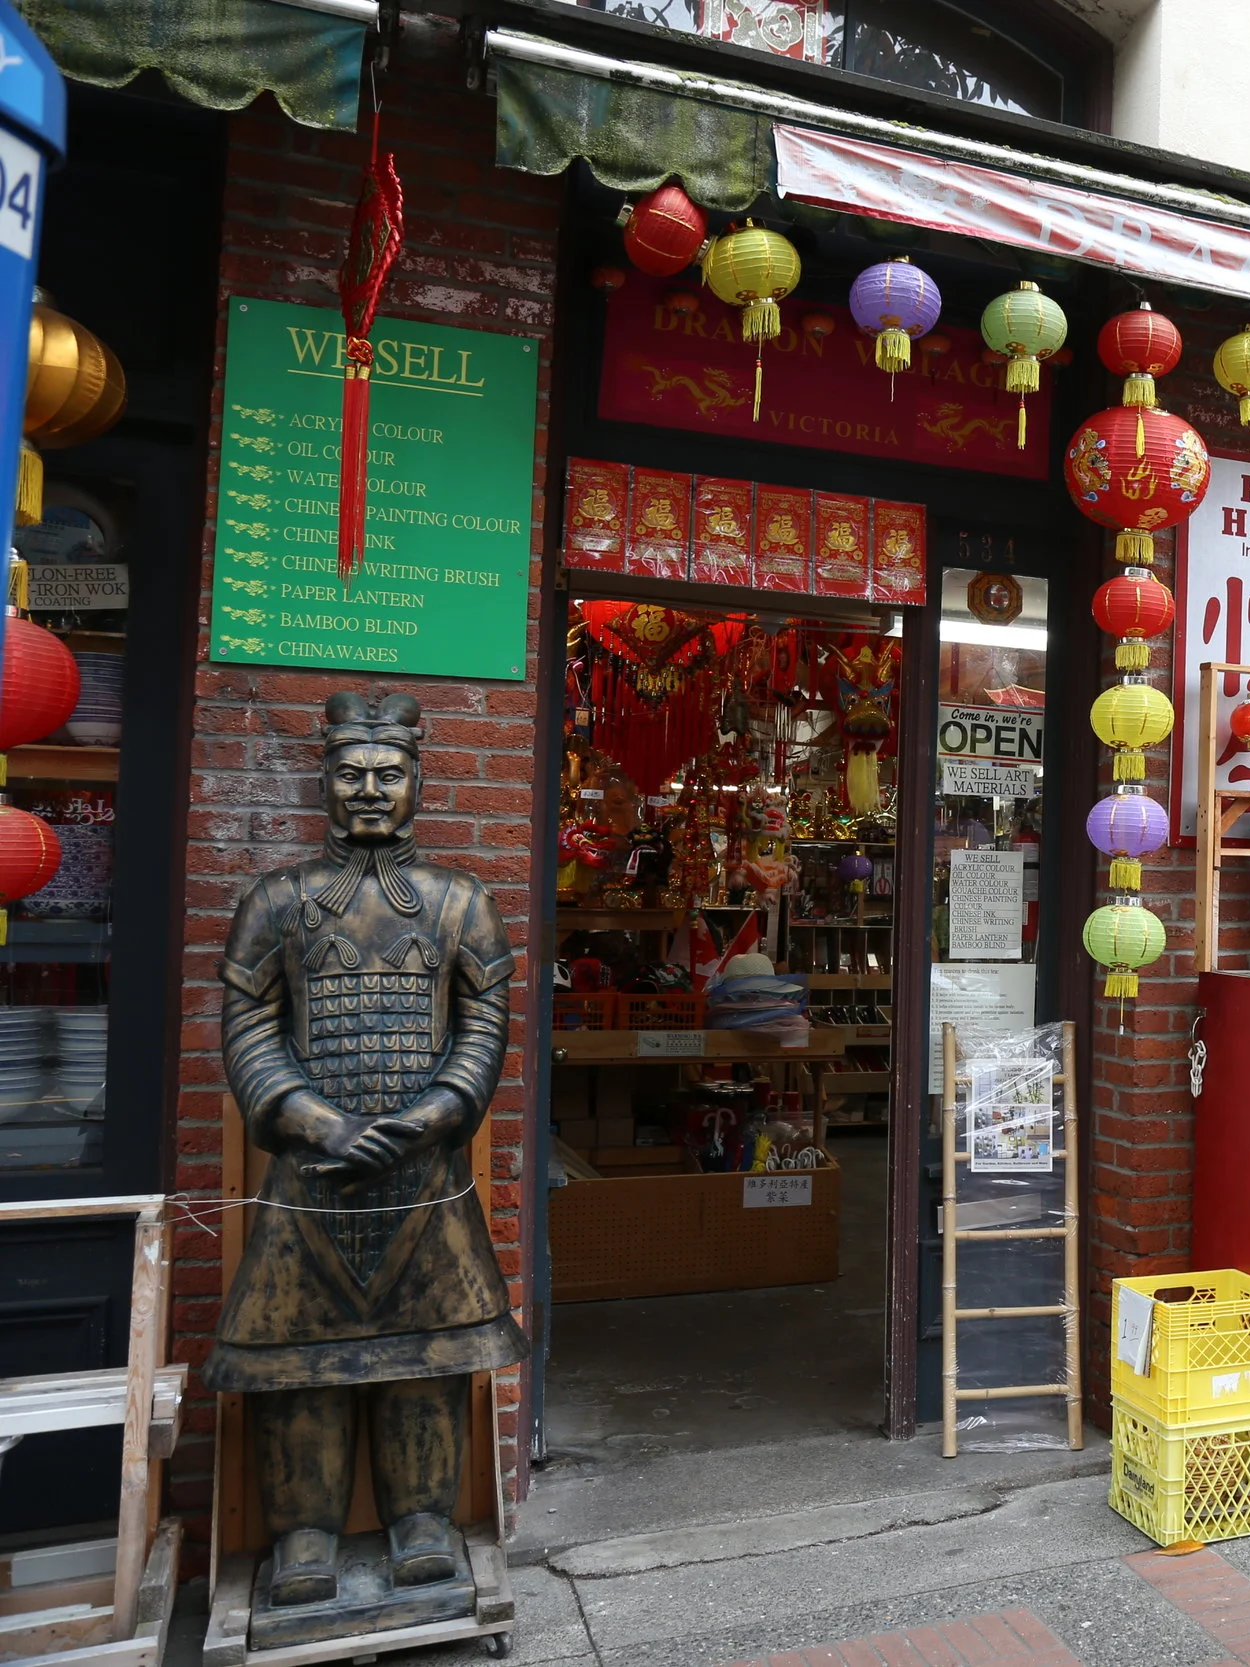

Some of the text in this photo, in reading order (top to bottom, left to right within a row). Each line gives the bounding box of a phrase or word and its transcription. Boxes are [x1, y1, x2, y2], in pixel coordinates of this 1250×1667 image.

[0, 156, 31, 230] 4
[654, 304, 825, 358] DRAON
[376, 338, 485, 387] SELL
[289, 412, 444, 444] ACRY COLOUR
[768, 410, 899, 446] VICTORIA
[287, 440, 319, 458] OIL
[287, 469, 426, 497] WATE OLOUR
[284, 497, 521, 535] CHINE PAINTING COLOUR
[578, 488, 616, 521] 福
[641, 498, 678, 530] 福
[706, 506, 745, 538] 福
[765, 515, 800, 546] 福
[826, 522, 859, 552] 福
[283, 526, 396, 550] CHINE INK
[883, 530, 916, 560] 福
[282, 554, 501, 587] CHINEE WRITING BRUSH
[34, 596, 91, 607] COATING
[85, 582, 127, 596] WOK
[281, 583, 424, 608] PAPER LANTERN
[280, 612, 418, 636] BAMBOO BLIND
[278, 640, 398, 663] CHINAWARES
[951, 708, 1032, 726] Come in, we're
[939, 720, 1043, 760] OPEN
[947, 766, 1030, 783] WE SELL ART
[953, 780, 1027, 796] MATERIALS
[965, 854, 1000, 863] WE SELL
[952, 887, 986, 895] GOUACHE
